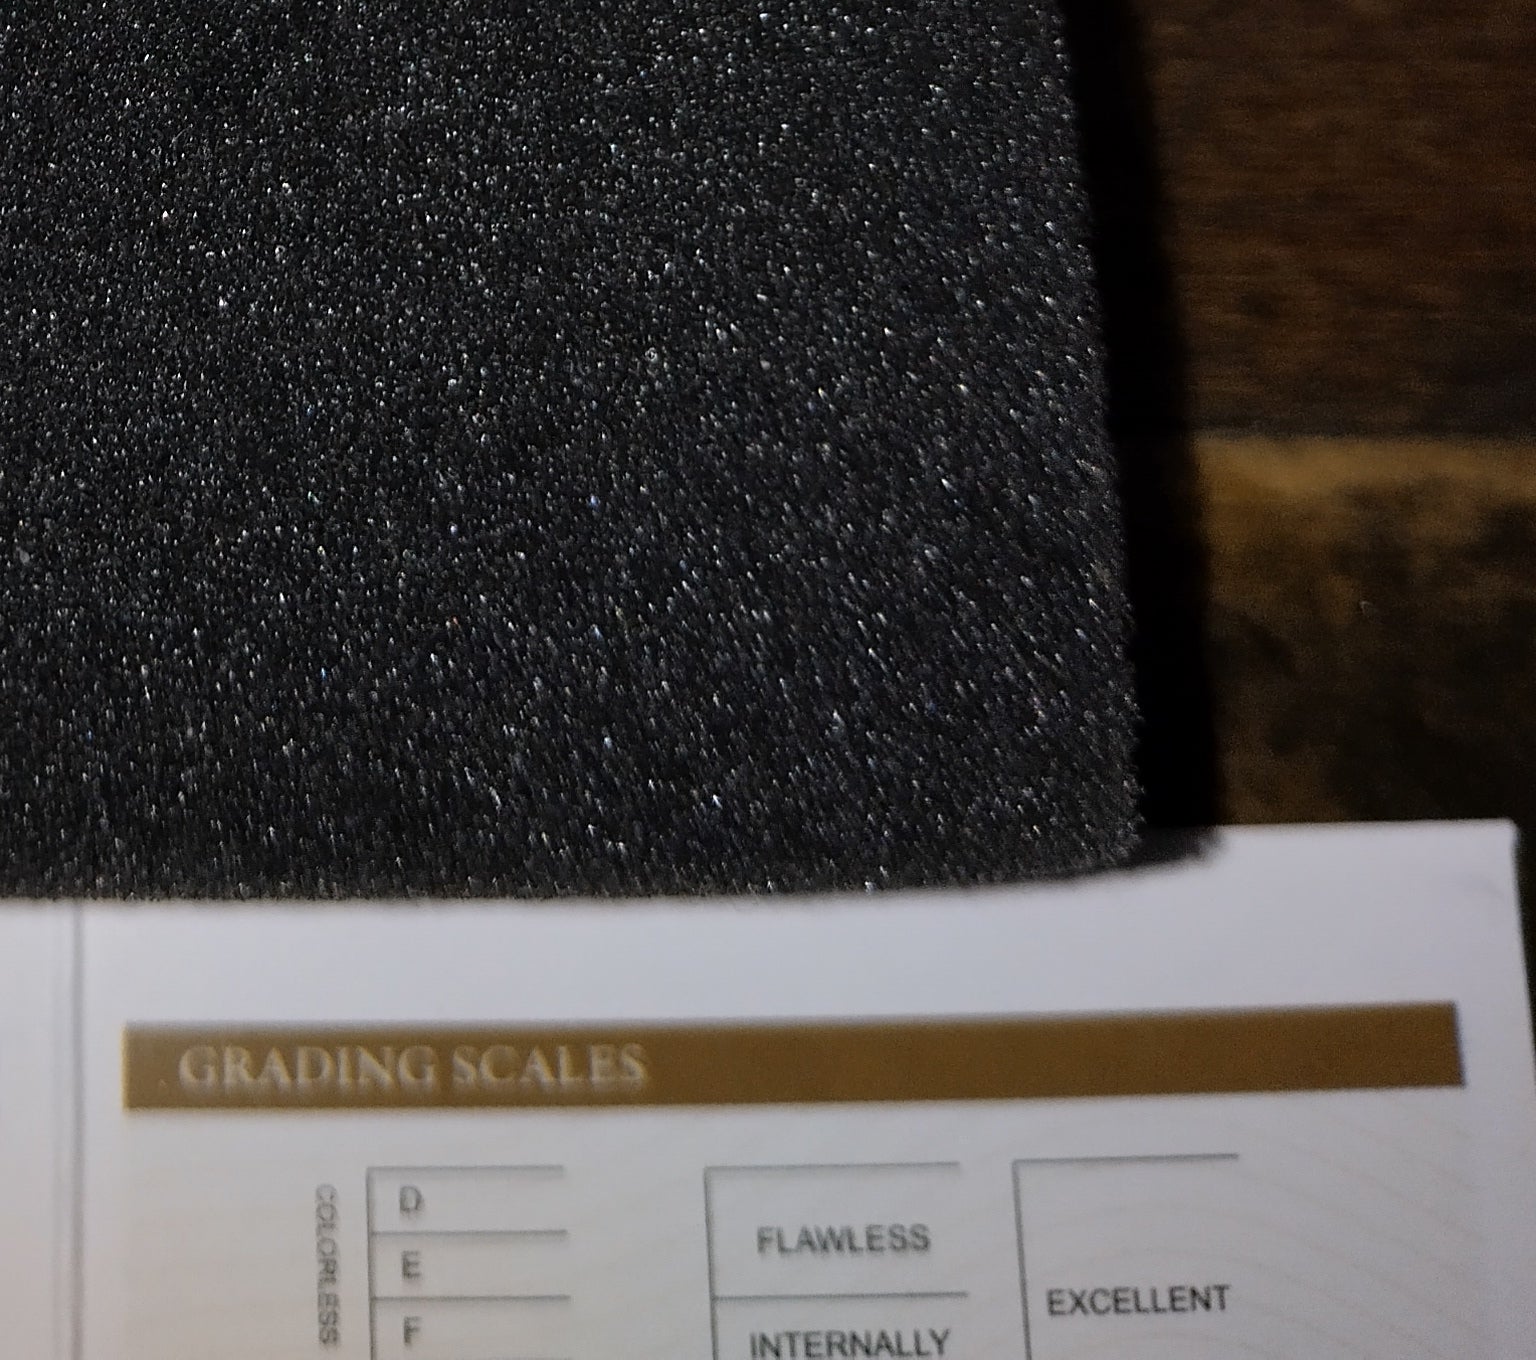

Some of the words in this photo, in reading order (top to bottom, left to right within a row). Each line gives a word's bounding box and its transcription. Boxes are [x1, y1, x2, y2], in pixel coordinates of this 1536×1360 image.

[177, 1044, 440, 1091] GRADING
[451, 1042, 650, 1091] SCALES
[399, 1184, 424, 1214] D
[756, 1223, 932, 1256] FLAWLESS
[315, 1183, 340, 1348] COLORLESS
[401, 1249, 422, 1280] E
[1047, 1283, 1232, 1318] EXCELLENT
[403, 1315, 422, 1347] F
[749, 1327, 952, 1360] INTERNALLY
